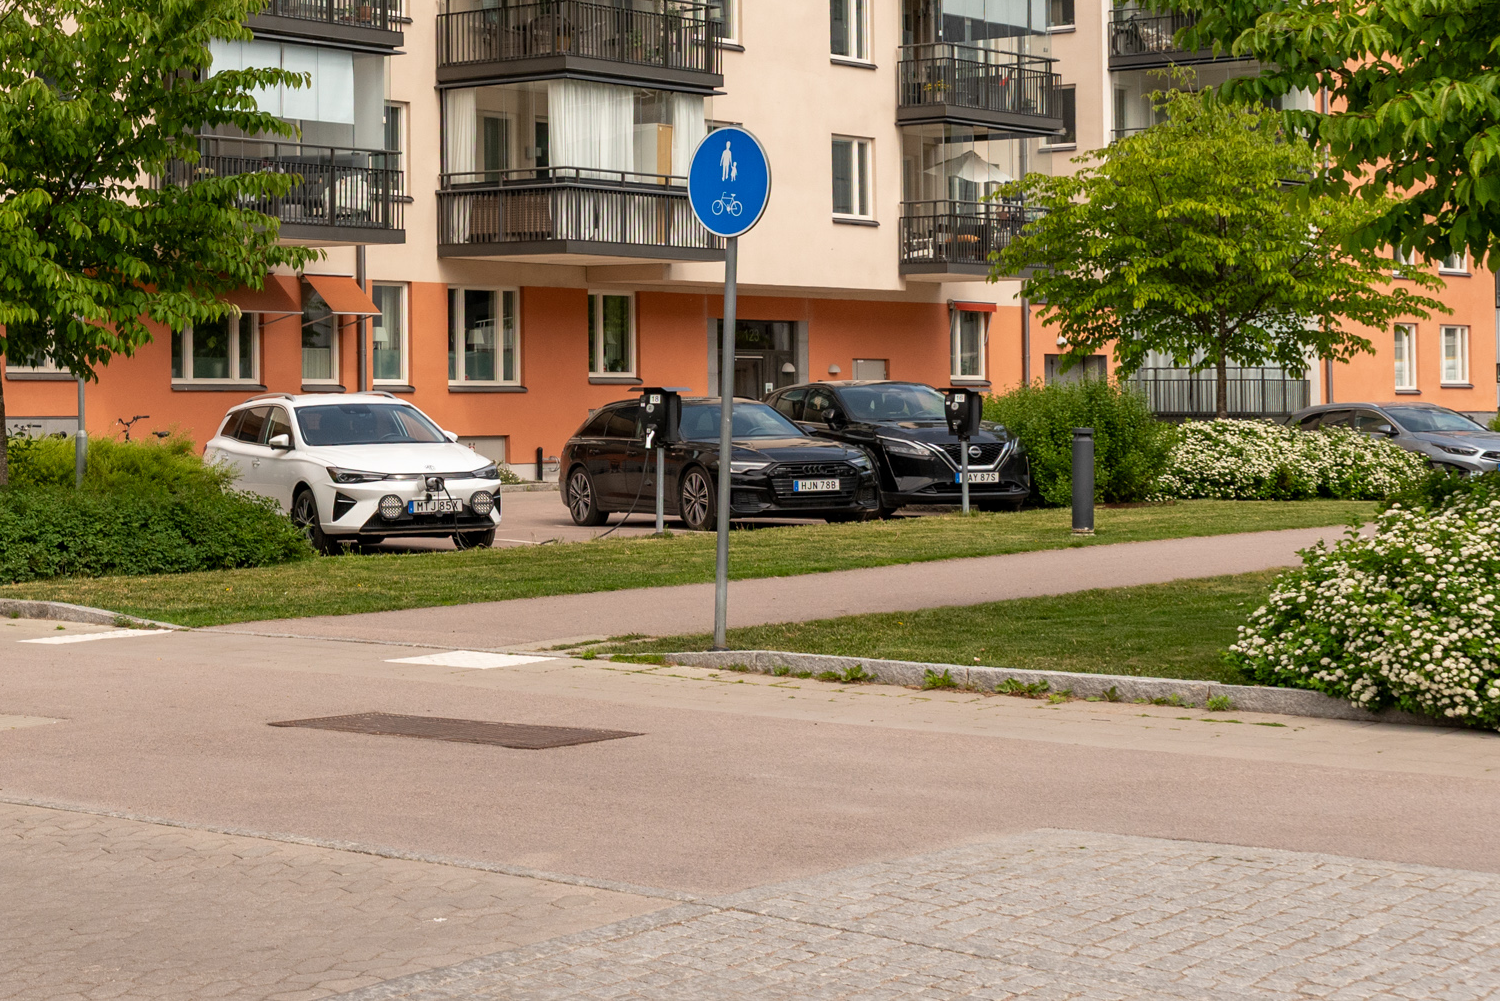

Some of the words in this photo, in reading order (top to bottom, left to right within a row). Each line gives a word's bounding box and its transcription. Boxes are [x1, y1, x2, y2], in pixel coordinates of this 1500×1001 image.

[964, 473, 978, 482] AY
[801, 481, 818, 490] HJN
[416, 501, 436, 511] MTJ
